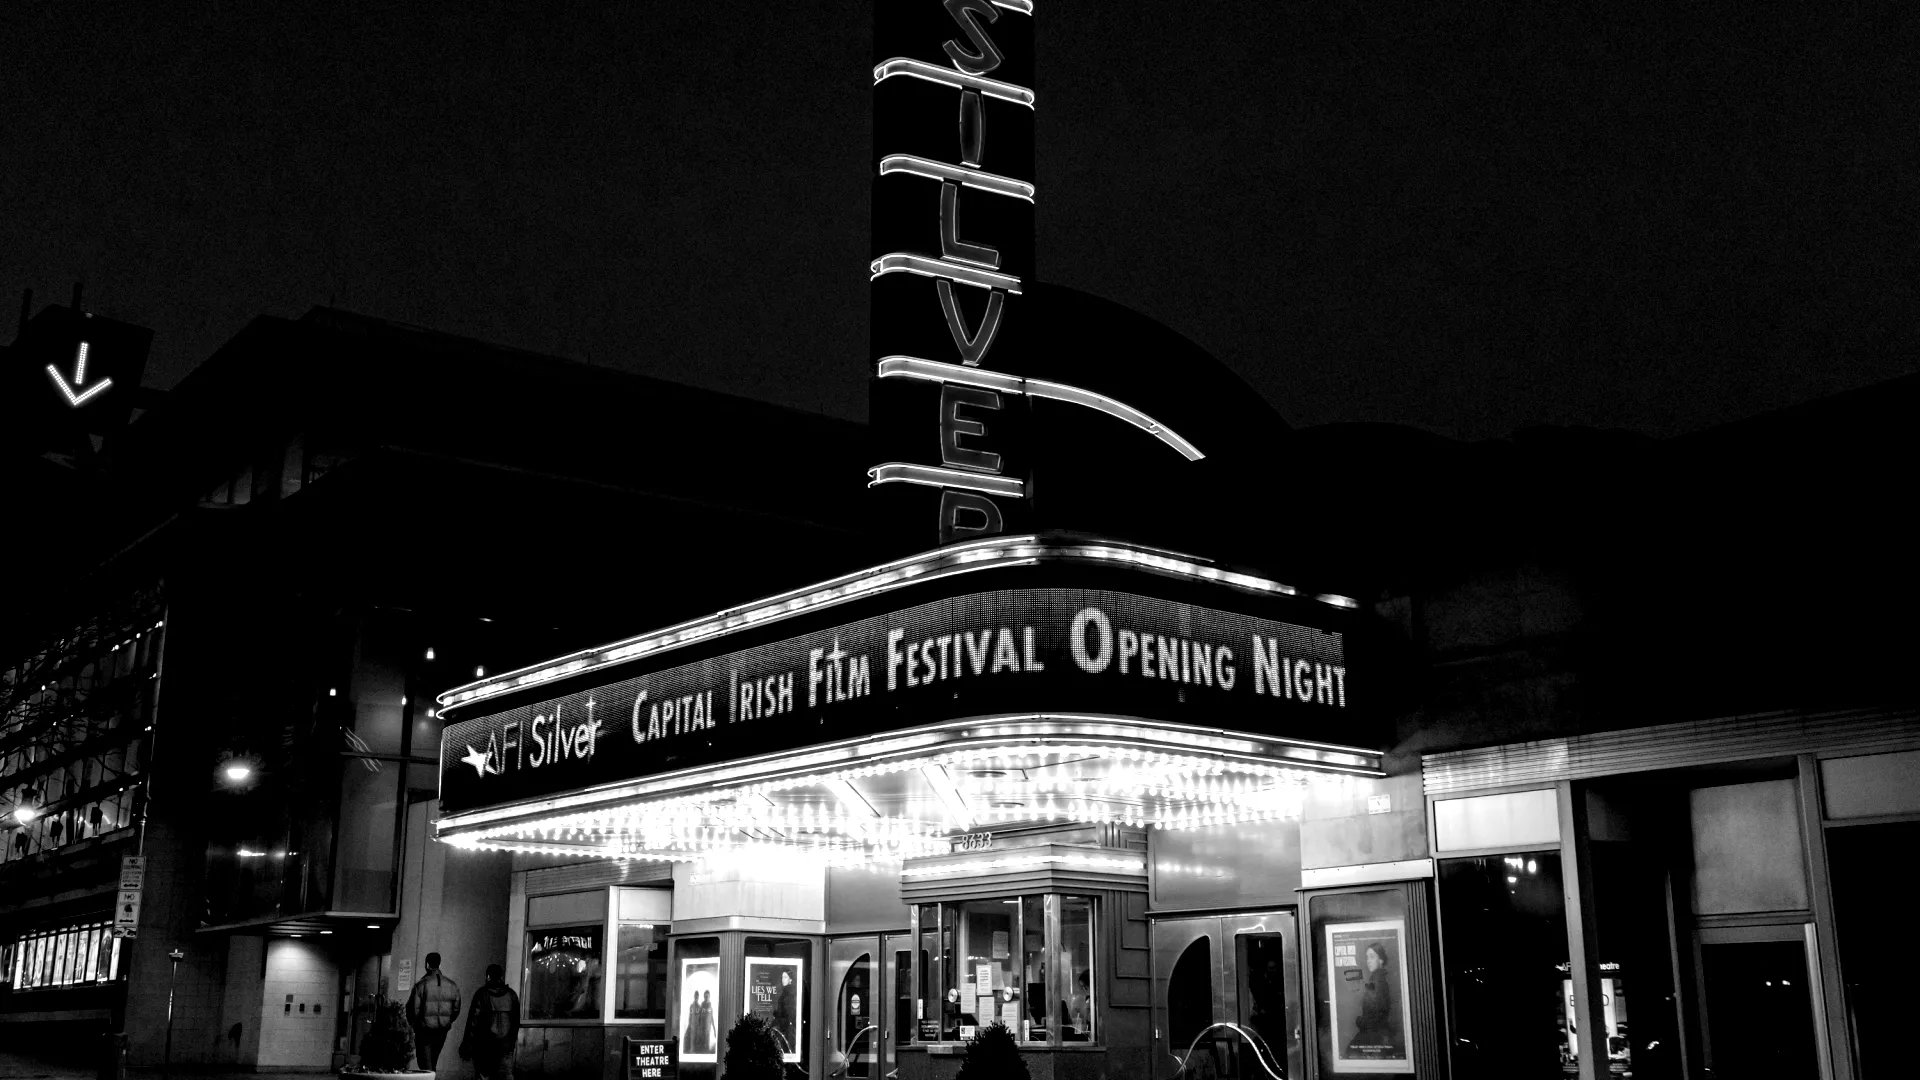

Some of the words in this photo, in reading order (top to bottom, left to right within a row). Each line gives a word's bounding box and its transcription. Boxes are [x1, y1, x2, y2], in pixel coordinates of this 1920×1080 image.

[486, 720, 524, 775] AFI
[530, 698, 602, 768] Silver
[962, 832, 992, 849] 8633
[124, 893, 135, 901] NO
[751, 985, 765, 994] LIES
[765, 986, 778, 995] WE
[756, 993, 773, 1002] TELL
[640, 1044, 665, 1055] ENTER
[636, 1055, 669, 1066] THEATRE
[642, 1067, 662, 1078] HERE
